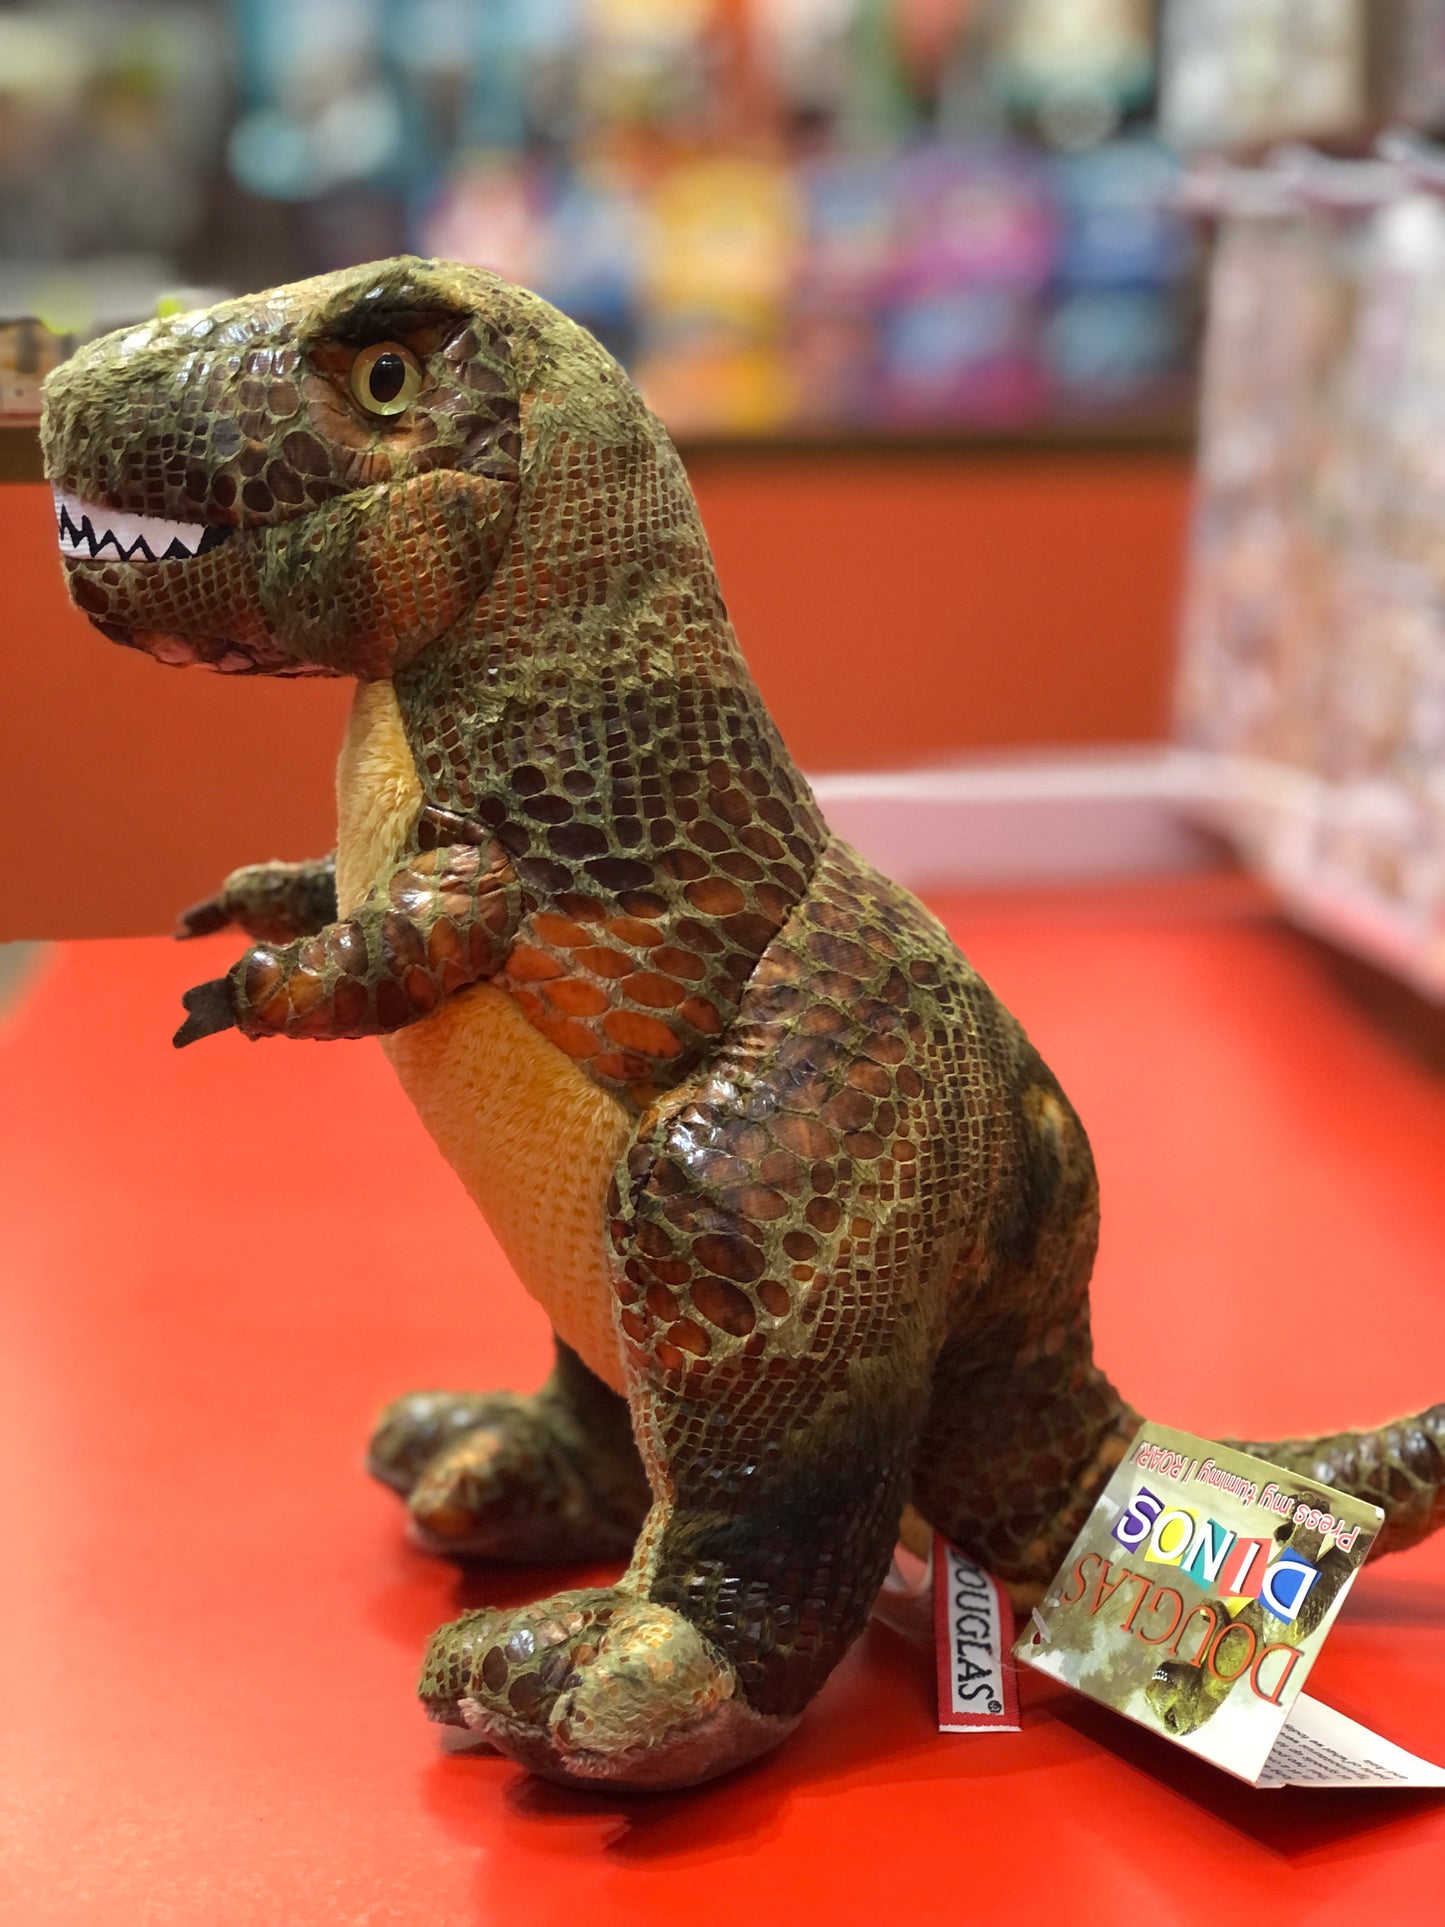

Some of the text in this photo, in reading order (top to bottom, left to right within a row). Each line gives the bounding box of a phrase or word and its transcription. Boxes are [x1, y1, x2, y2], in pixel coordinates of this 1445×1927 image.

[1130, 1440, 1188, 1480] ROAR!
[1196, 1458, 1259, 1507] tummy
[1258, 1482, 1296, 1515] my
[1292, 1502, 1361, 1554] Press
[1116, 1494, 1318, 1620] DINOS
[1060, 1552, 1305, 1707] DOUGLAS
